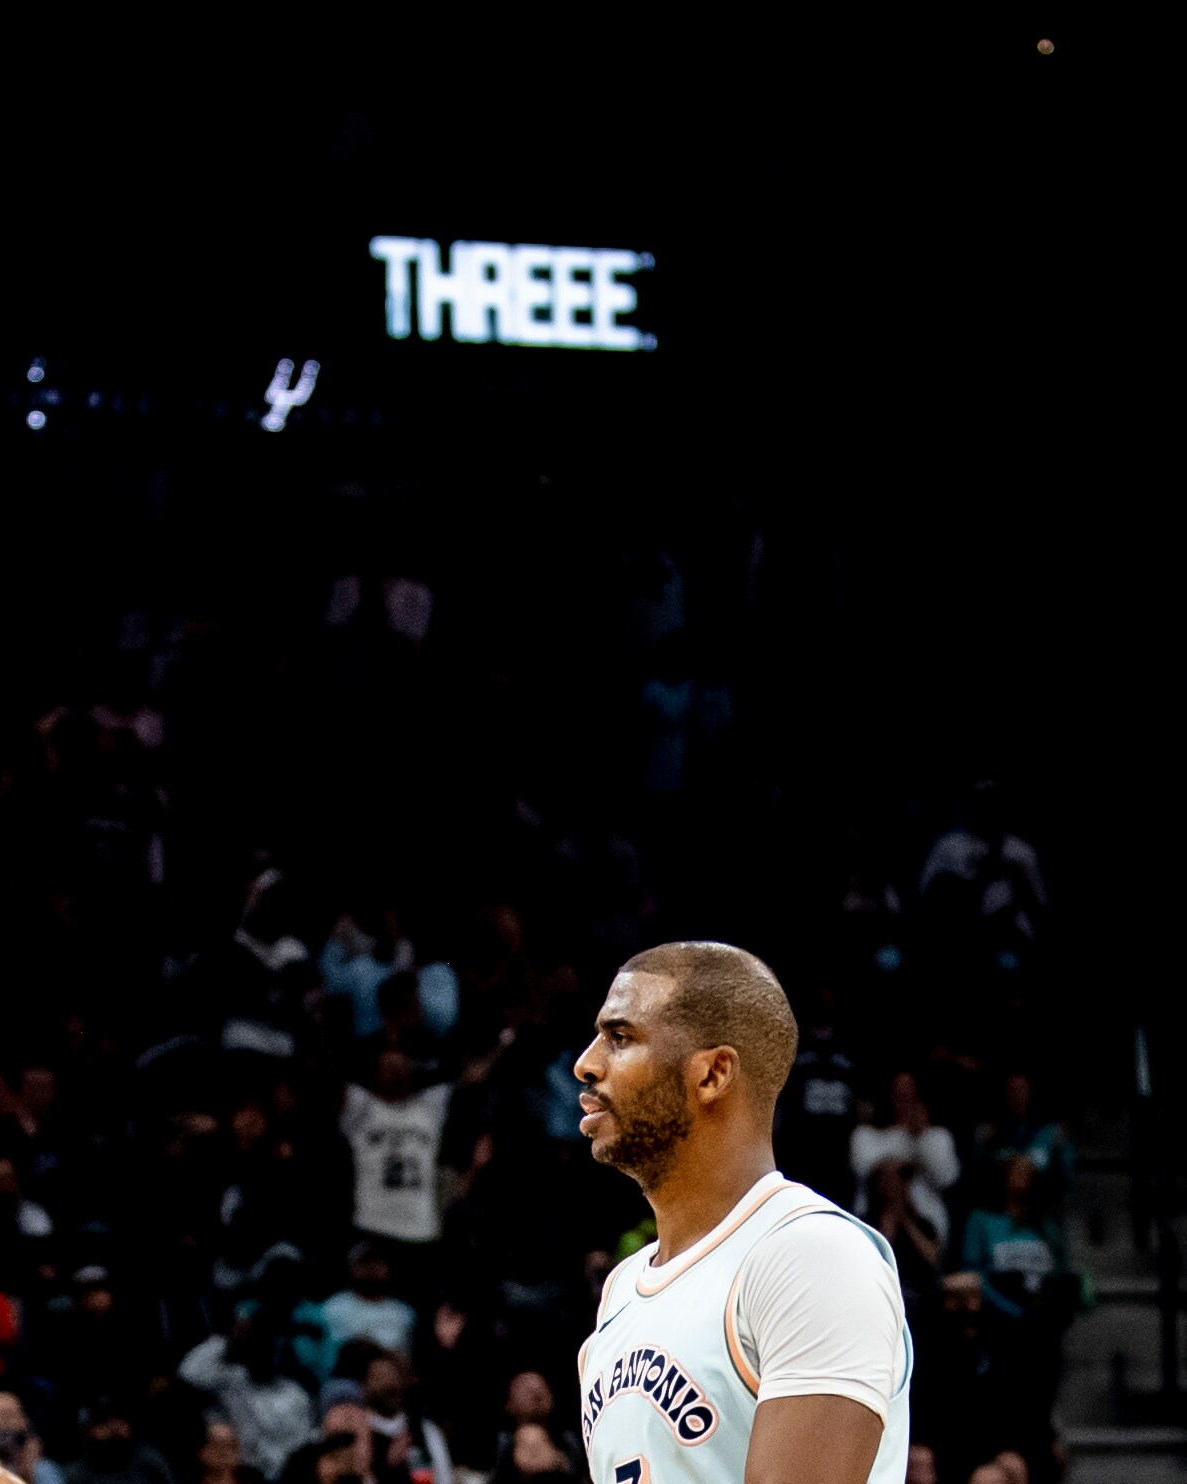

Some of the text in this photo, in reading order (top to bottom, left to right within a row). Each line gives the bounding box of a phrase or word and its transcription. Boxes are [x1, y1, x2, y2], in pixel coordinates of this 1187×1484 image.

[369, 235, 641, 351] THREEE
[582, 1347, 715, 1446] AN ANTONIO
